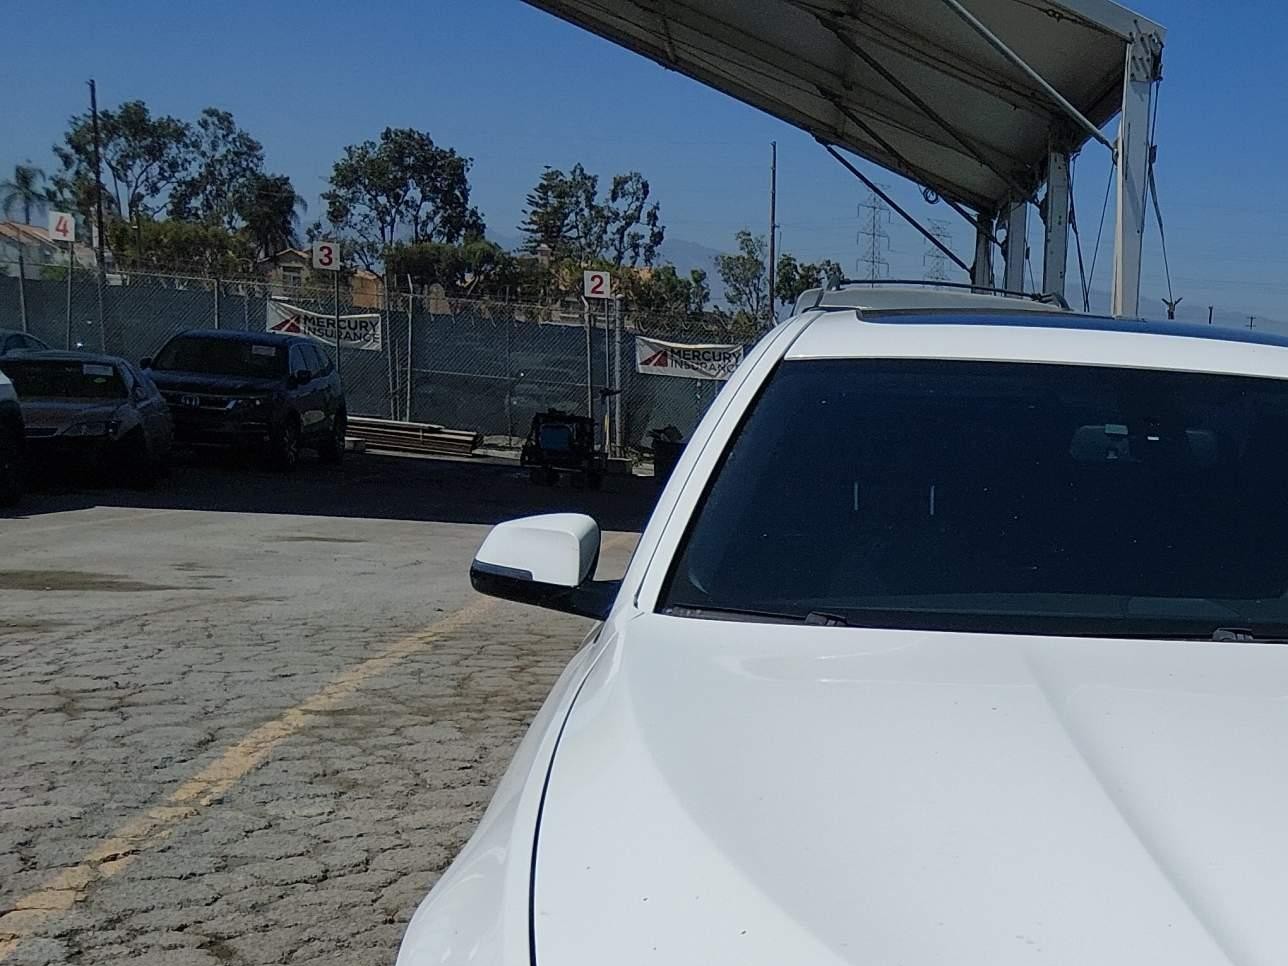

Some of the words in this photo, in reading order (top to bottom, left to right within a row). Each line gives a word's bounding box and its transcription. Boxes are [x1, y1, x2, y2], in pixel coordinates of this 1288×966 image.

[56, 215, 69, 237] 4
[319, 245, 333, 266] 3
[591, 275, 605, 295] 2
[303, 314, 379, 332] MERCURY
[303, 326, 380, 343] INSURANCE
[671, 348, 742, 365] MERCURY
[670, 359, 737, 373] INSURANC
